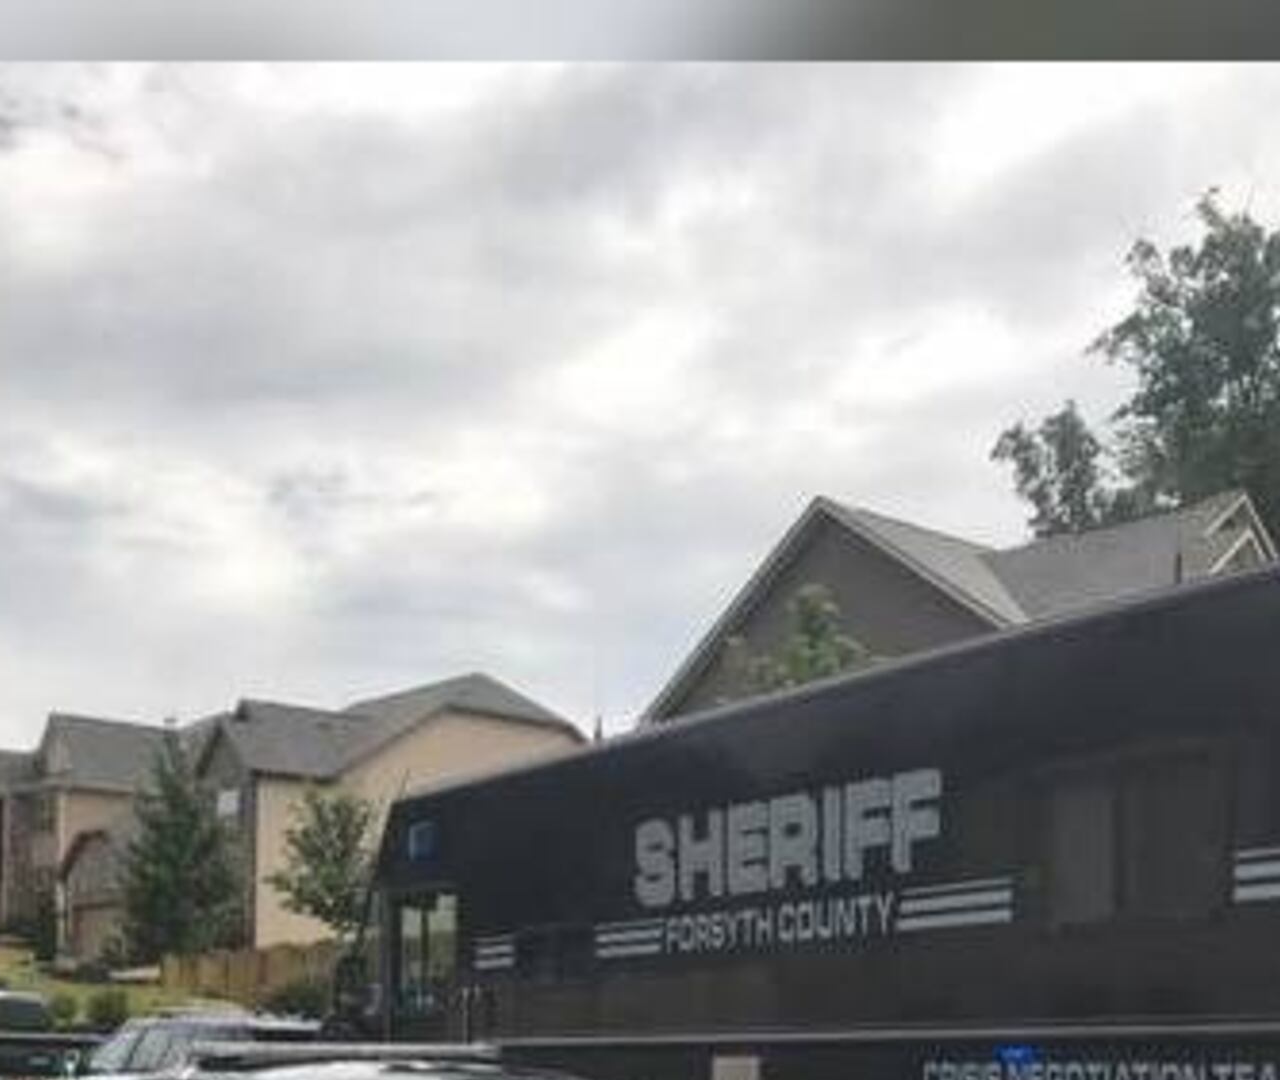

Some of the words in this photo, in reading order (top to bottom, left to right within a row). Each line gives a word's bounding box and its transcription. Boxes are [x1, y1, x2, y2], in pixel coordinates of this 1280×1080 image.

[634, 768, 941, 907] SHERIFF
[666, 906, 773, 953] FORSYTH
[779, 890, 893, 943] COUNTY
